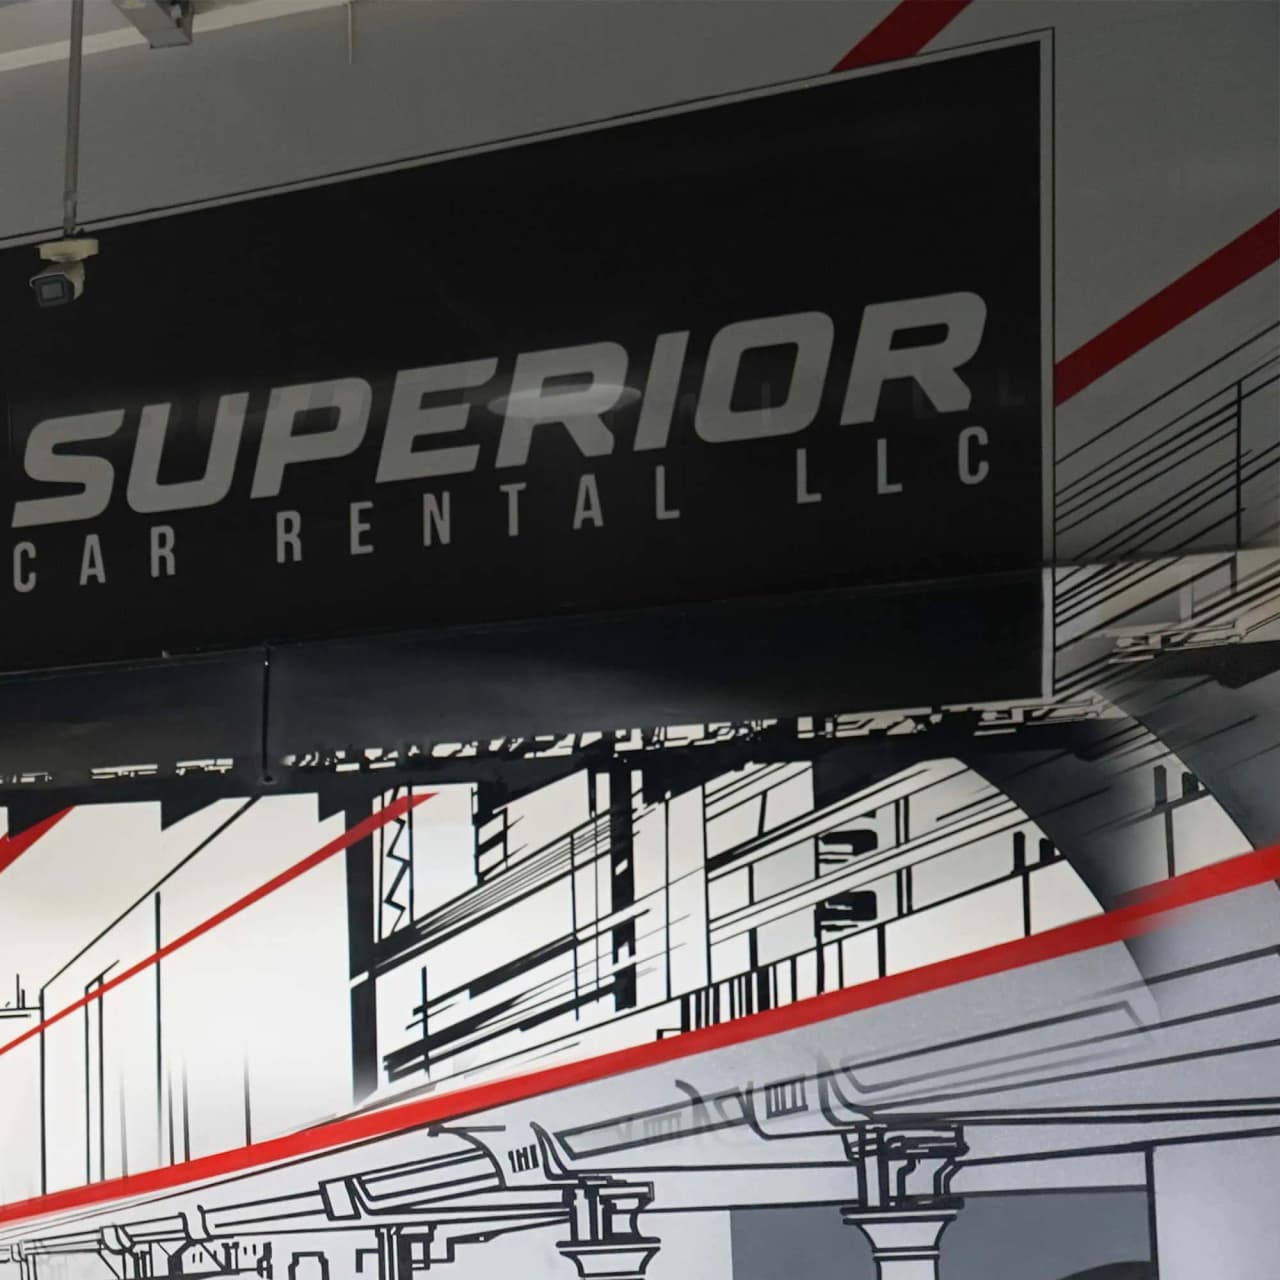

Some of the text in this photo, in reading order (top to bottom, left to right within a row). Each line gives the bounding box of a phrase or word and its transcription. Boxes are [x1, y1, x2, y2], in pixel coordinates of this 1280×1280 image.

[11, 291, 987, 528] SUPERIOR
[13, 426, 989, 593] CAR RENTAL LLC
